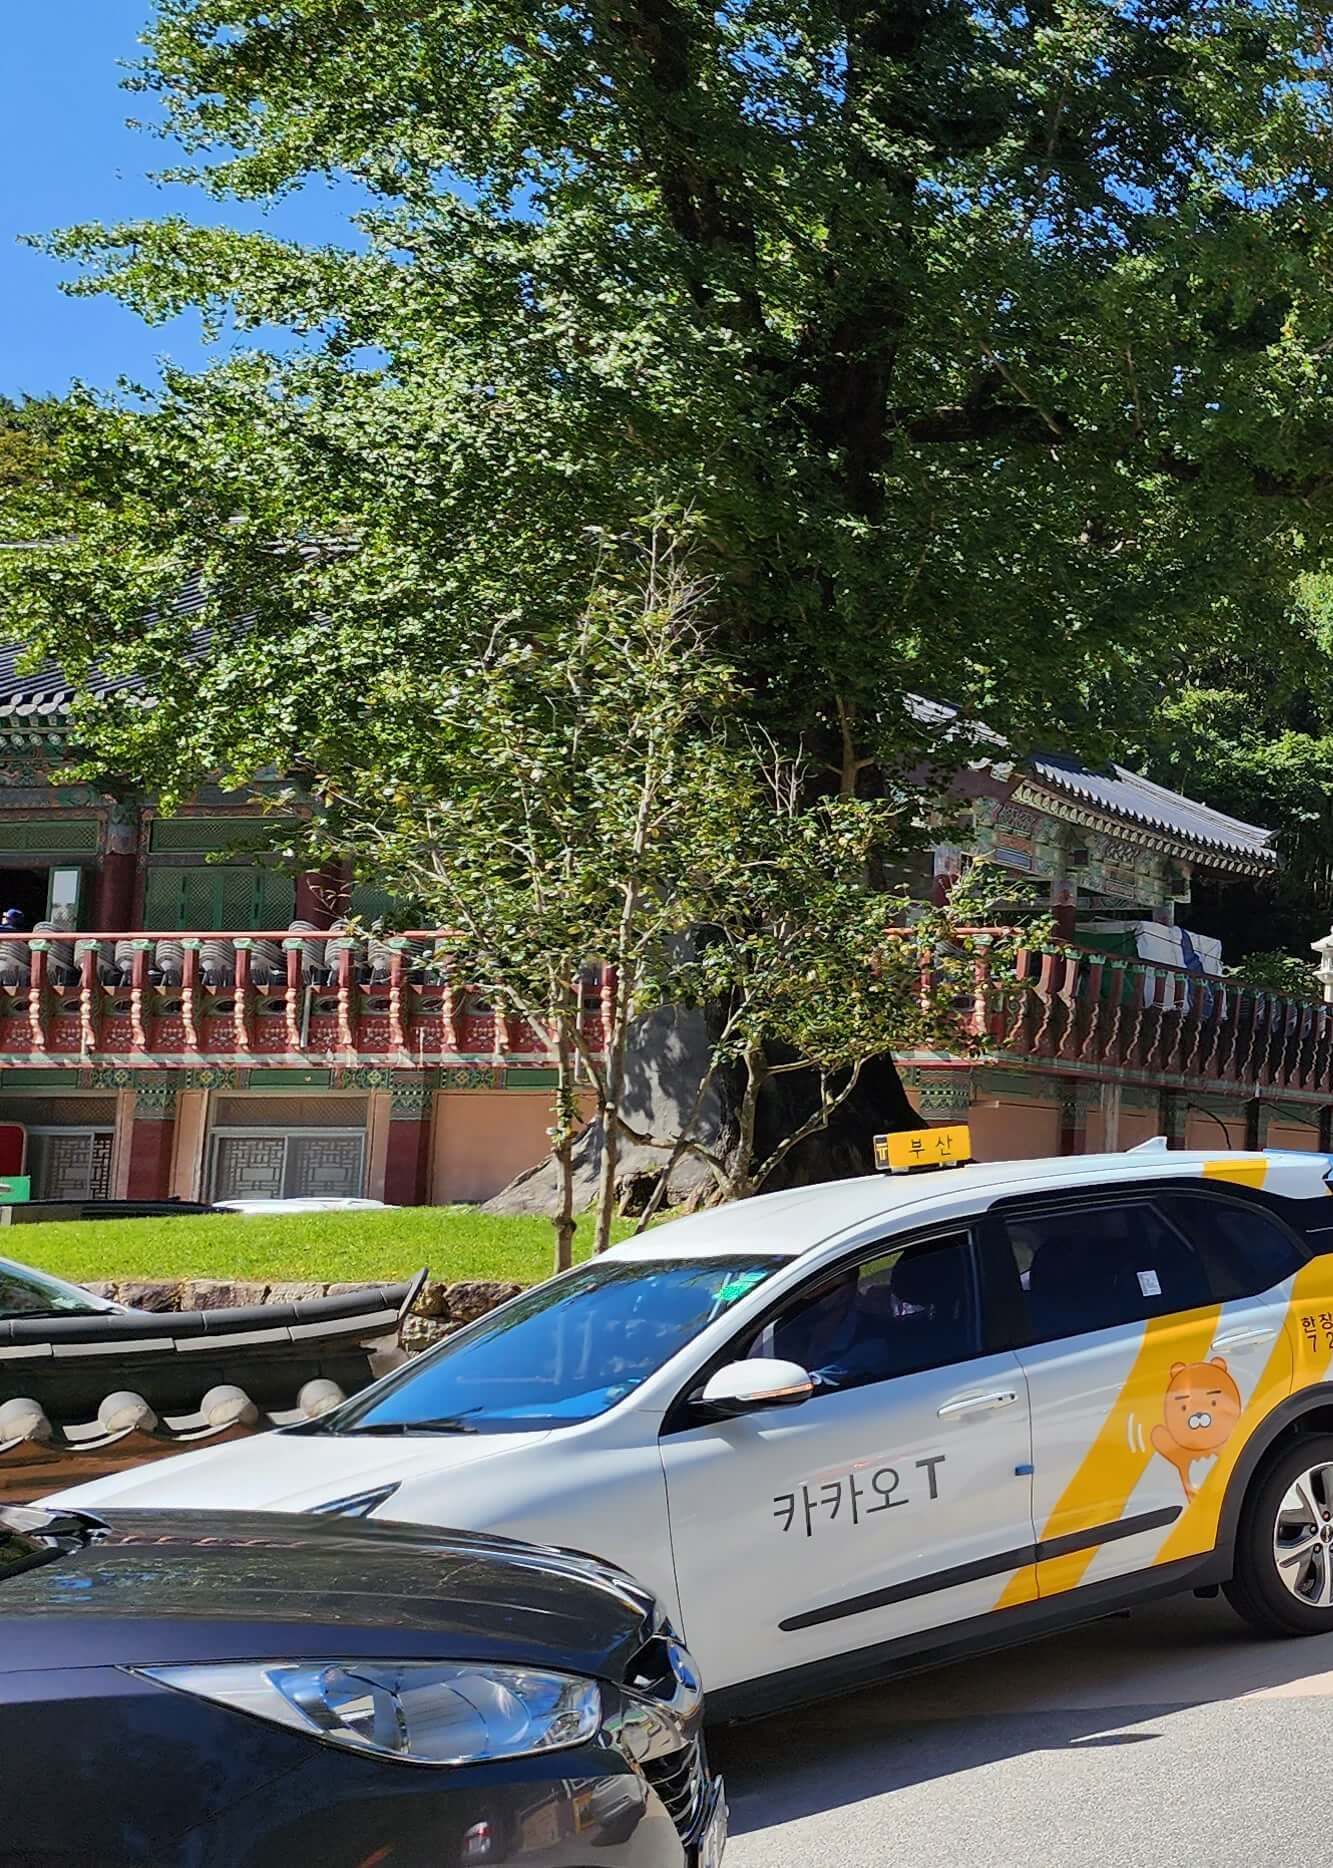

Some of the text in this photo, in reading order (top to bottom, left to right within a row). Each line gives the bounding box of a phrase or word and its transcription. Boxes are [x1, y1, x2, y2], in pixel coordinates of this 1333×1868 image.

[908, 1134, 953, 1159] 부산
[773, 1454, 946, 1537] 카카오 T
